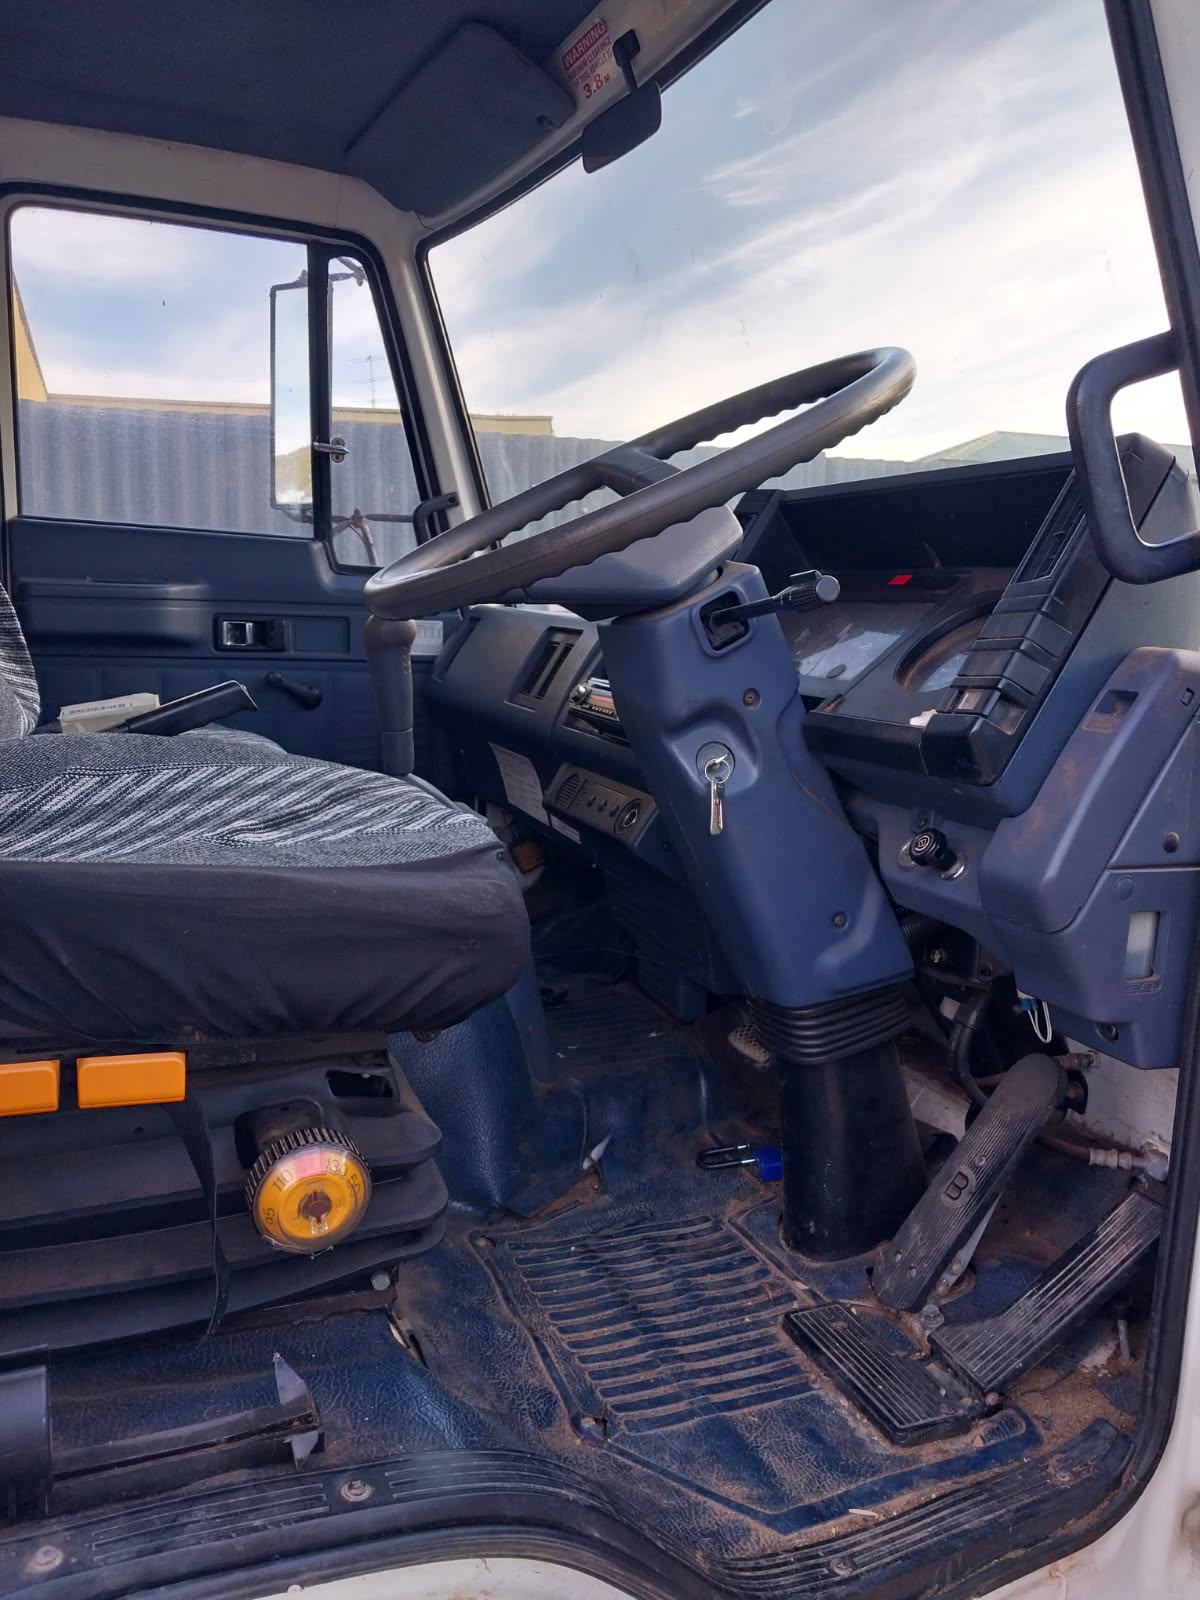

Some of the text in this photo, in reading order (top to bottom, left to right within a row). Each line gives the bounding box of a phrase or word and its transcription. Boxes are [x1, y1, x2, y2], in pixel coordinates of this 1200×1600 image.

[563, 22, 606, 68] WARNING
[583, 74, 604, 99] 3.8
[272, 1168, 294, 1192] 110
[326, 1158, 348, 1178] 130
[944, 1171, 969, 1200] B
[262, 1207, 277, 1226] 95
